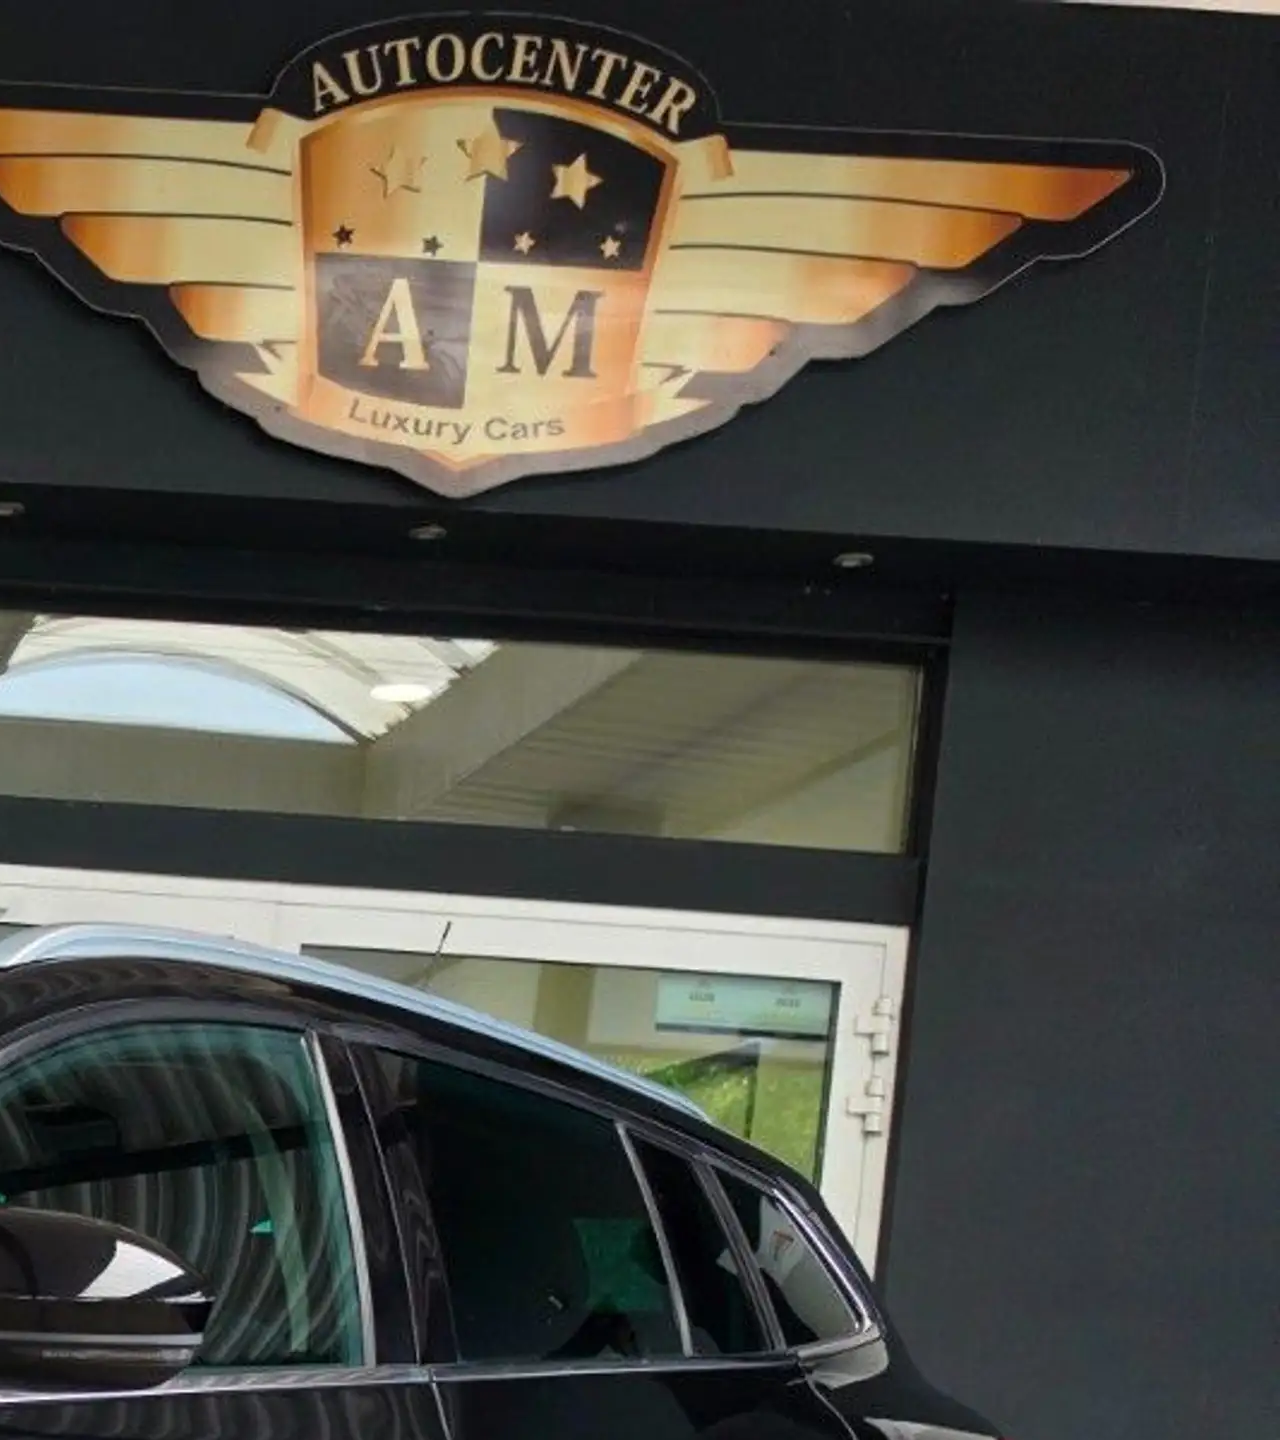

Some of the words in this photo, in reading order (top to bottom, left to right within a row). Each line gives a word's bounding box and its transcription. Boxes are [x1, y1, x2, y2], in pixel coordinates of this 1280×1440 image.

[312, 32, 696, 134] AUTOCENTER
[359, 278, 430, 371] A
[495, 285, 607, 378] M
[348, 398, 474, 446] Luxury
[483, 415, 566, 442] Cars
